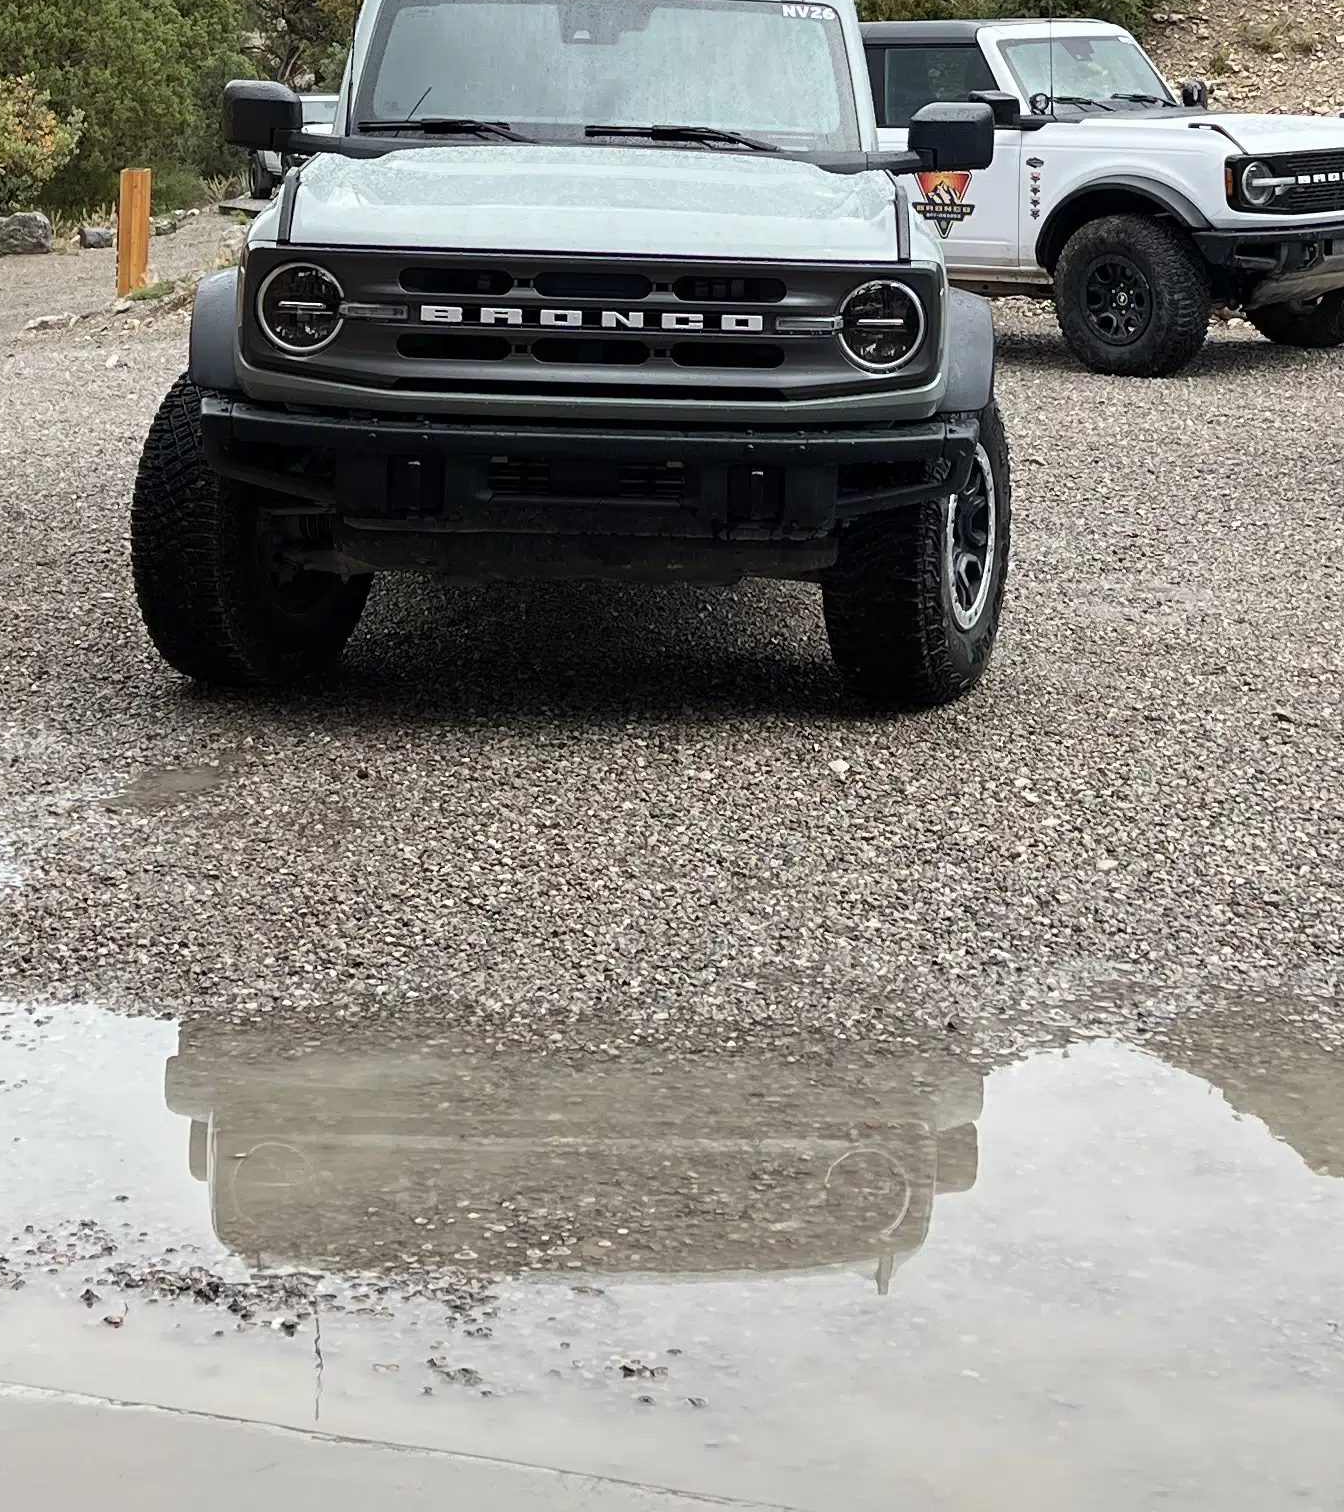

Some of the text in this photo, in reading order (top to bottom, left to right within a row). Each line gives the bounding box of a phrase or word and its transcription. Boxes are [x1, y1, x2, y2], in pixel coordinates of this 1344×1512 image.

[782, 4, 836, 20] NV26
[916, 204, 971, 213] BRONCO
[419, 304, 764, 332] BRONCO
